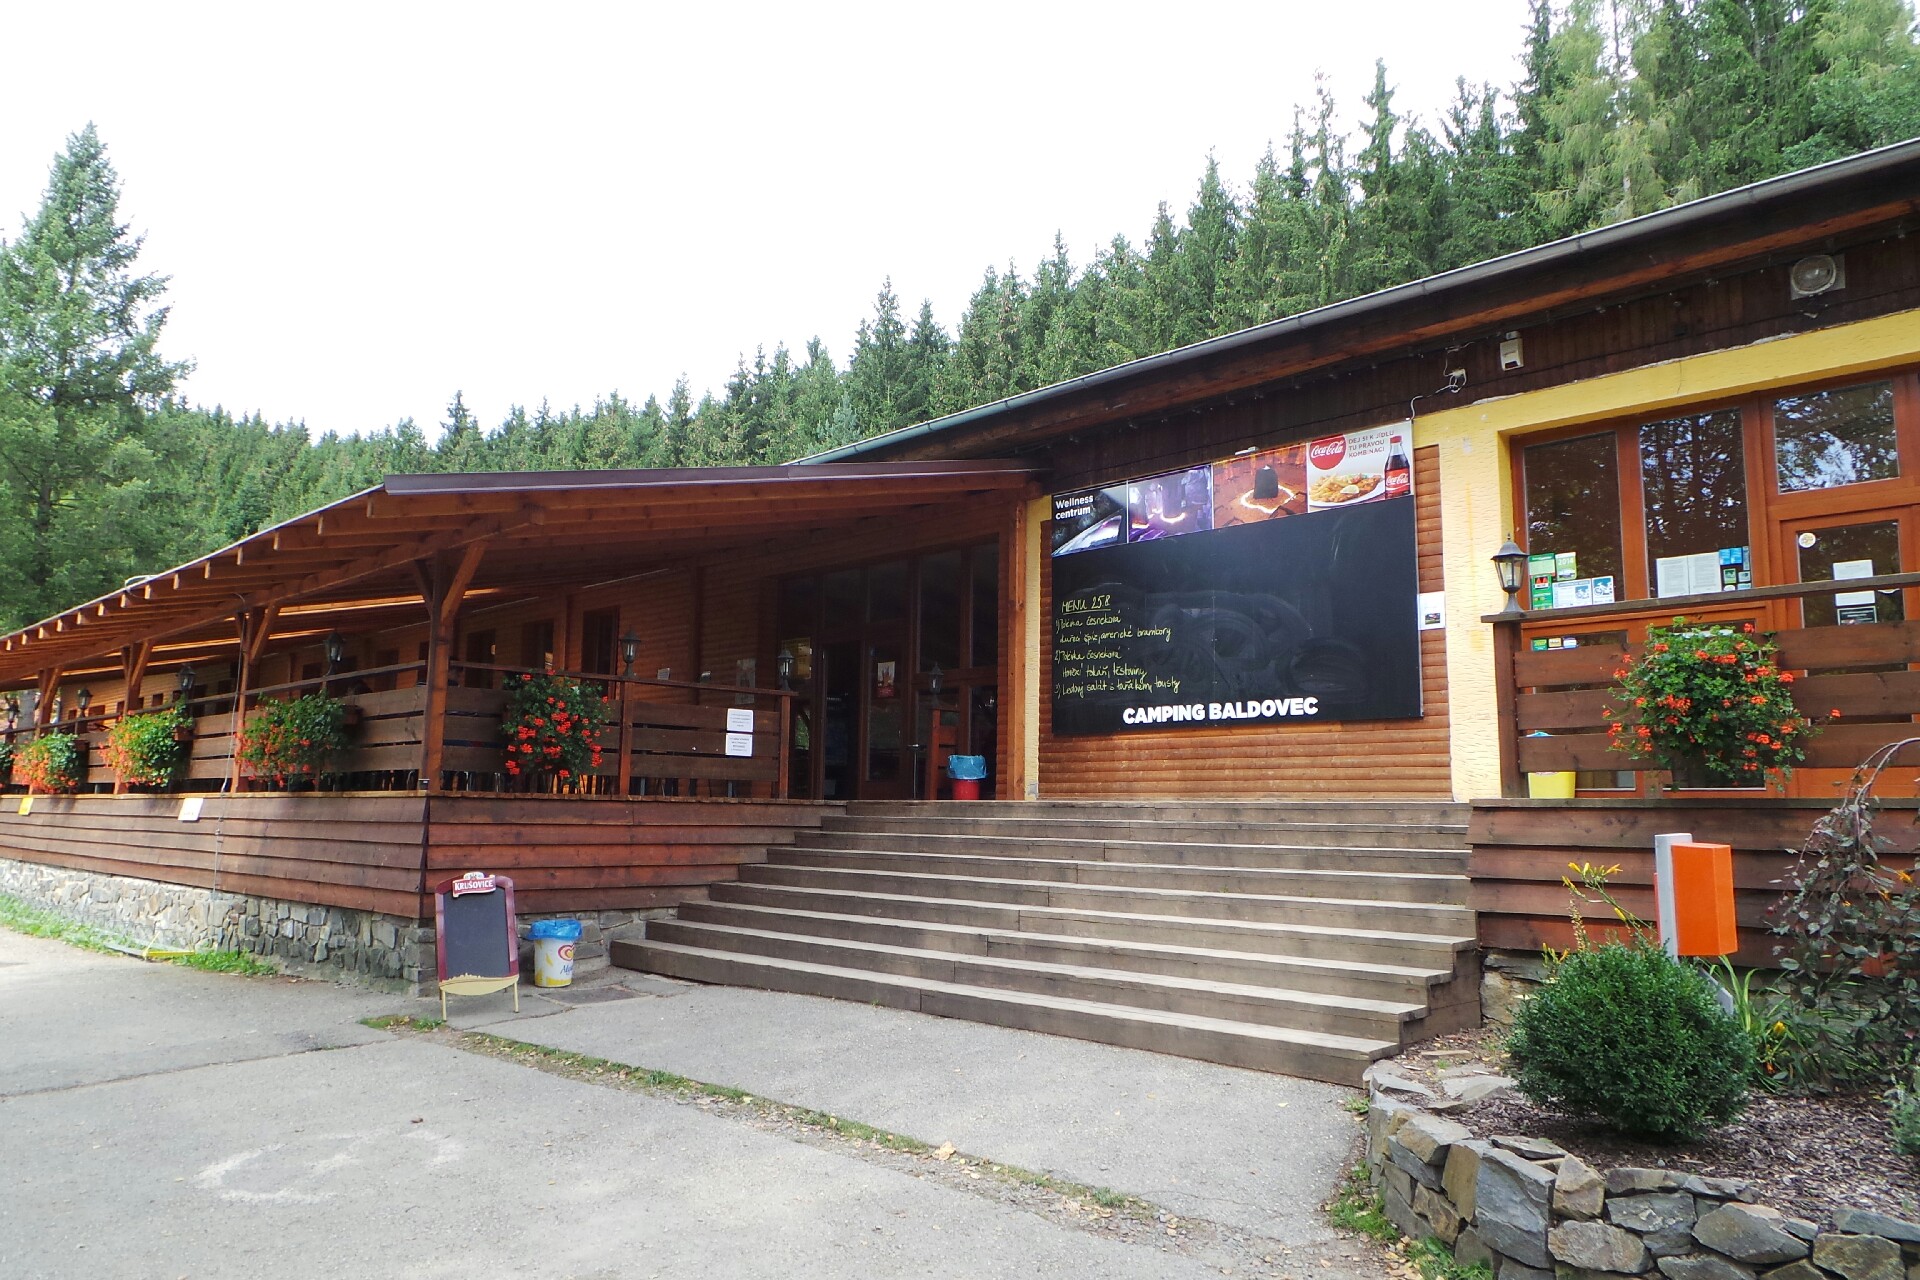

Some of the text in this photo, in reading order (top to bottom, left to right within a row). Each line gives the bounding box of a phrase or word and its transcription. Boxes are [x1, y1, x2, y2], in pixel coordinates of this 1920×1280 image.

[1348, 437, 1360, 445] DEJ
[1348, 439, 1385, 452] TU PRAVOU
[1056, 495, 1094, 510] Wellness
[1056, 506, 1091, 520] centrum
[1062, 599, 1088, 614] MENU
[1137, 624, 1172, 642] brambory
[1086, 679, 1108, 692] salát
[1122, 696, 1319, 724] CAMPING BALDOVEC
[454, 880, 494, 891] KRUŠOVICE
